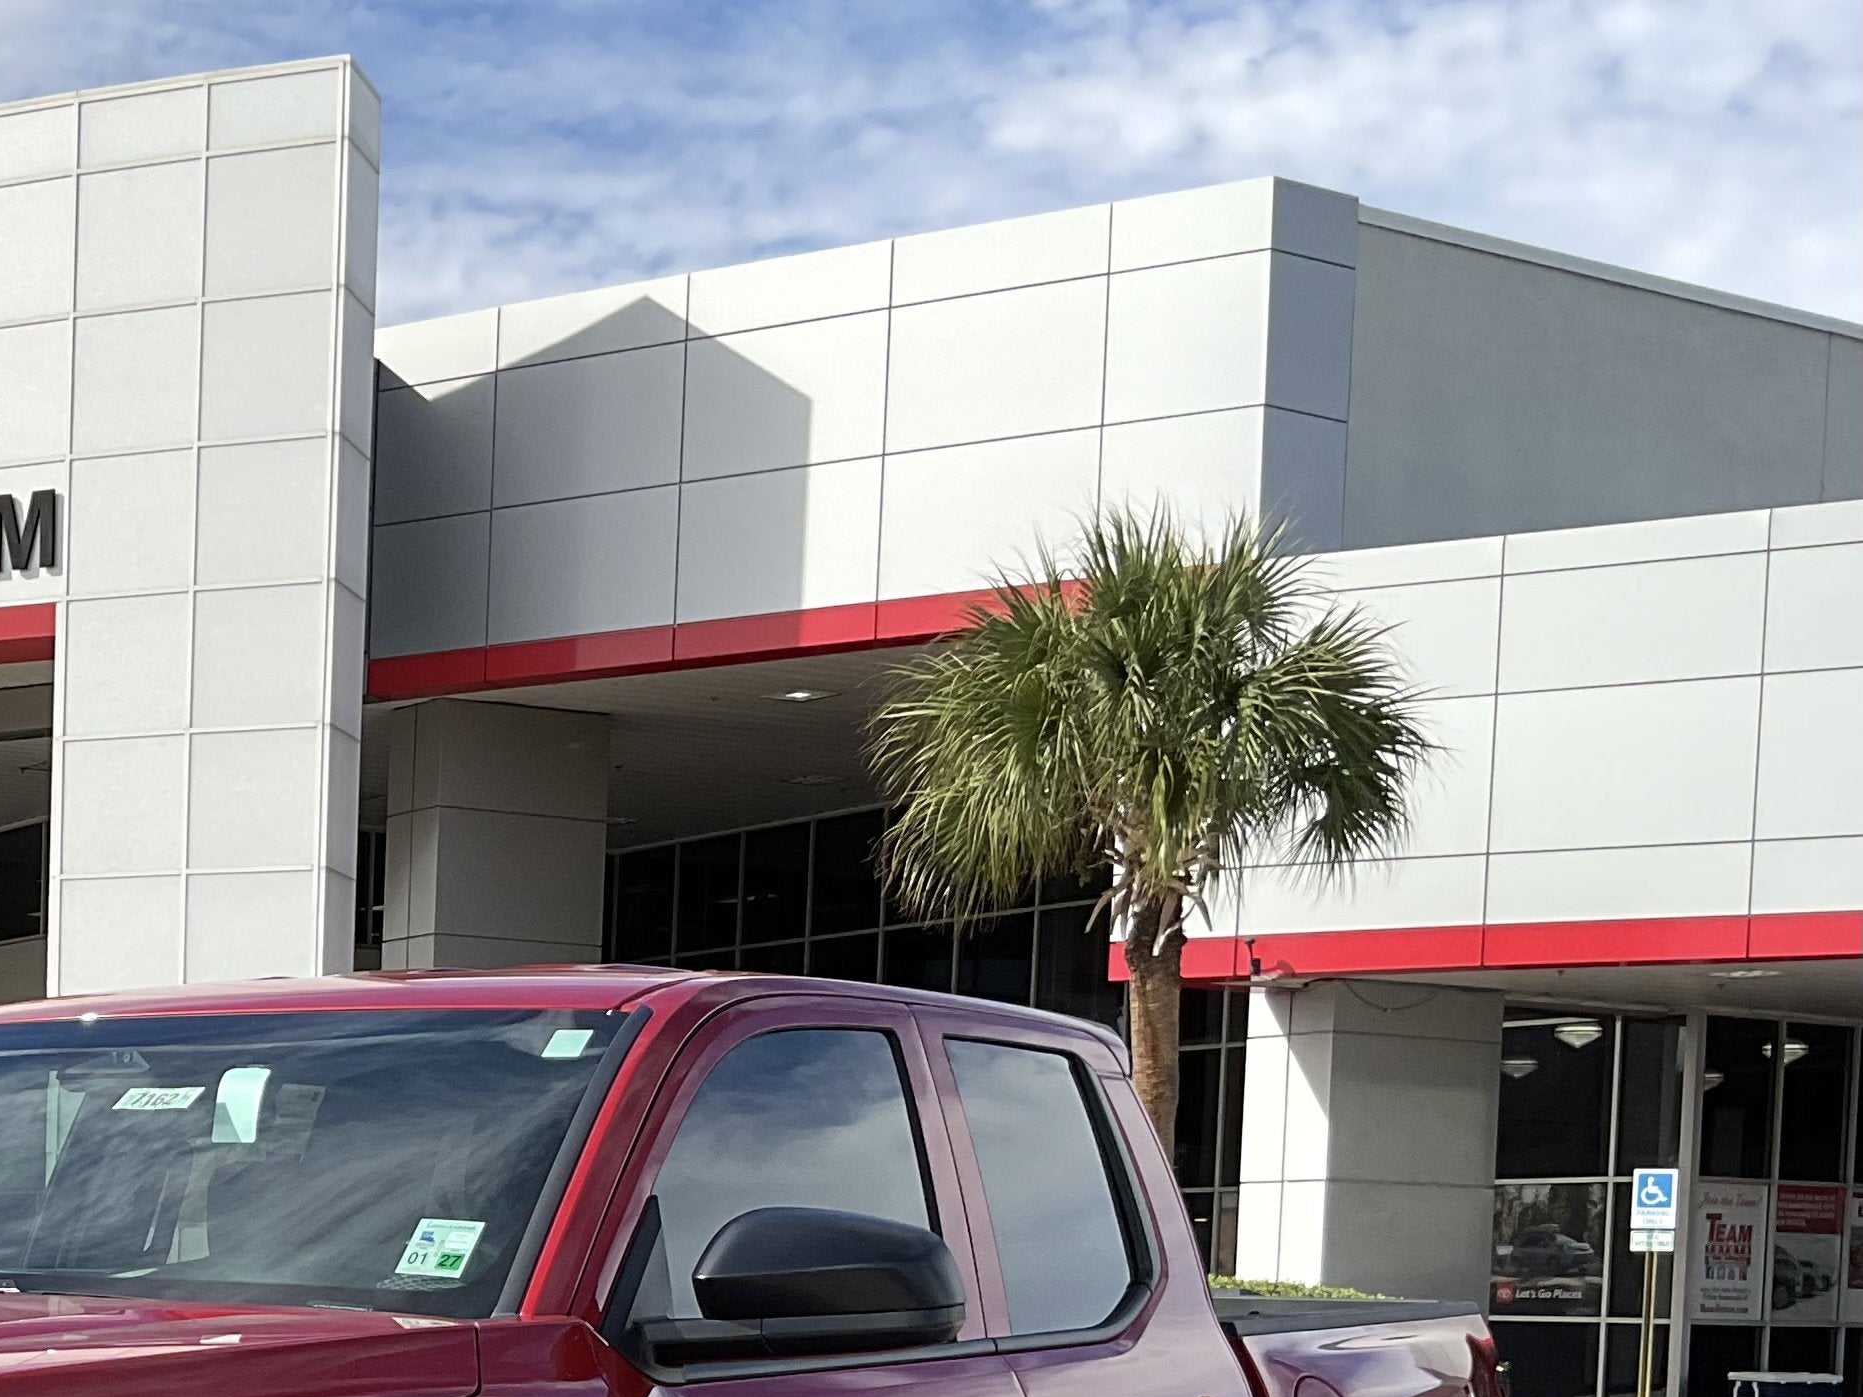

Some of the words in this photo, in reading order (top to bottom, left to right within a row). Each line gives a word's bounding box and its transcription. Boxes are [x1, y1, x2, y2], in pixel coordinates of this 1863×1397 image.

[1705, 1212, 1754, 1243] TEAM
[407, 1251, 429, 1265] 01
[437, 1254, 462, 1268] 27
[1515, 1289, 1536, 1299] Let's
[1538, 1288, 1552, 1299] Go
[1553, 1288, 1583, 1299] Places
